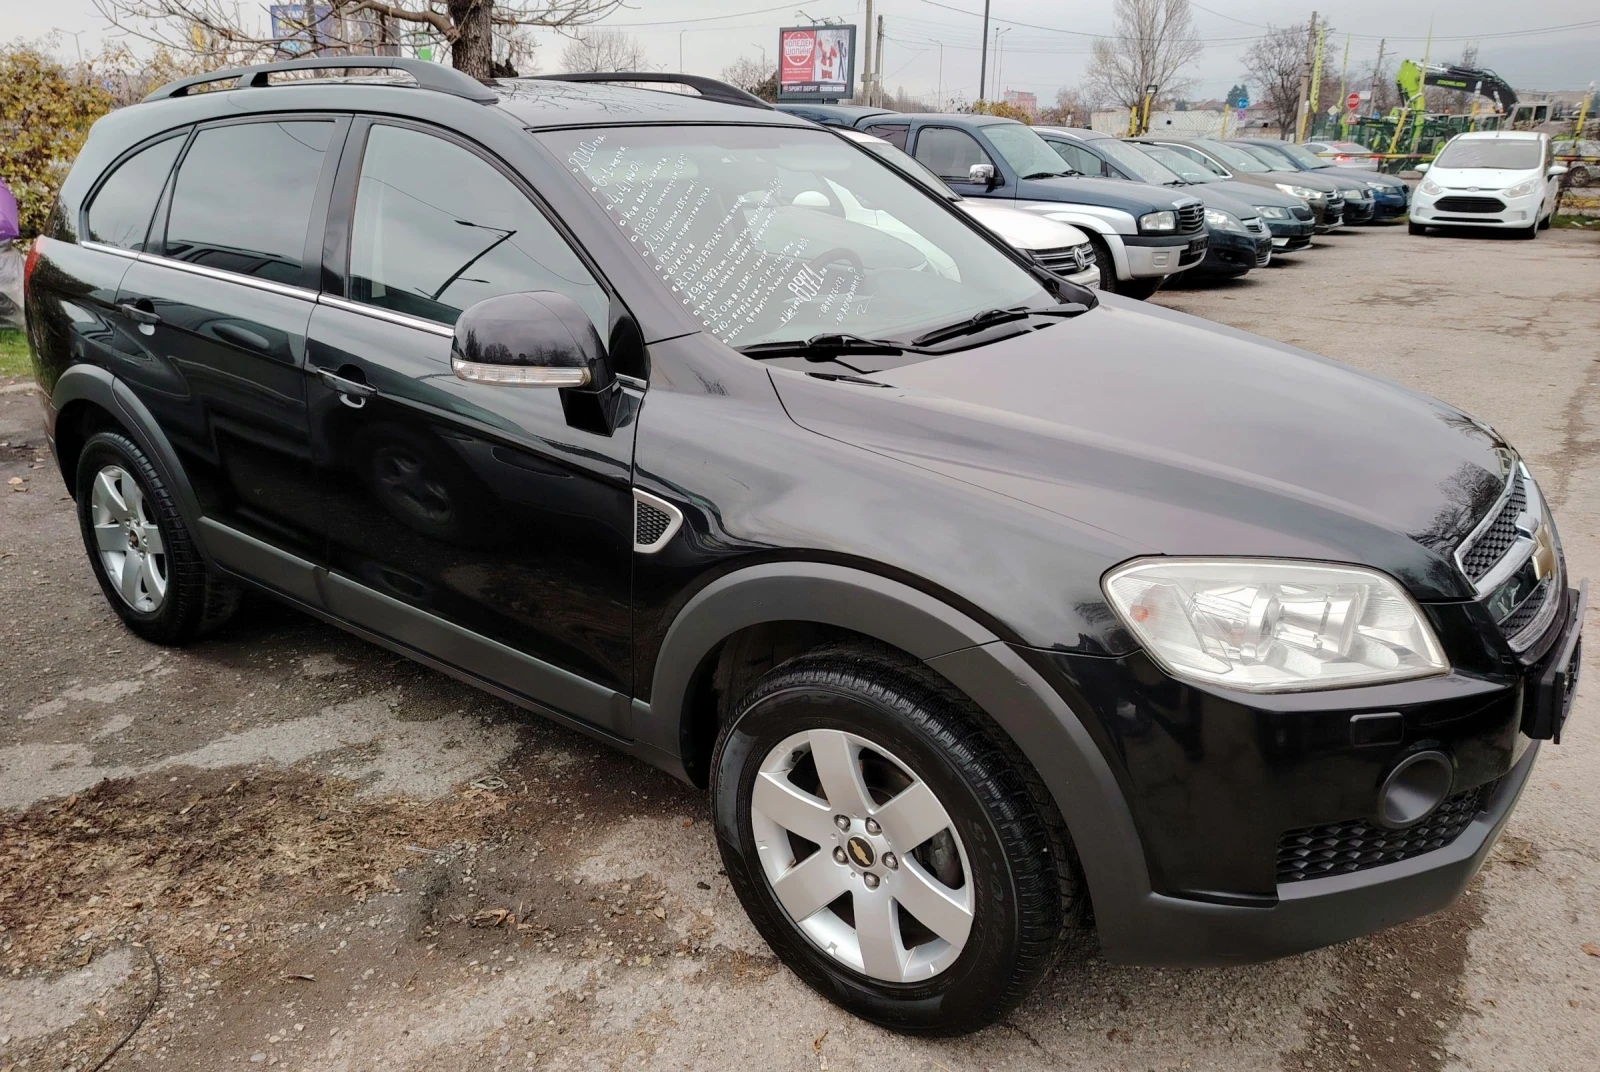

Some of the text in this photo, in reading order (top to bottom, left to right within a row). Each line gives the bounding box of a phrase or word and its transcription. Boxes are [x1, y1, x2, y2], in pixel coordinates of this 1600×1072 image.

[785, 40, 813, 48] КОЛЕДЕН
[785, 48, 812, 56] ШОПИНГ
[568, 141, 596, 171] 2010
[621, 206, 639, 220] Нов
[634, 206, 658, 236] ГАЗОВ
[787, 263, 824, 301] 8971
